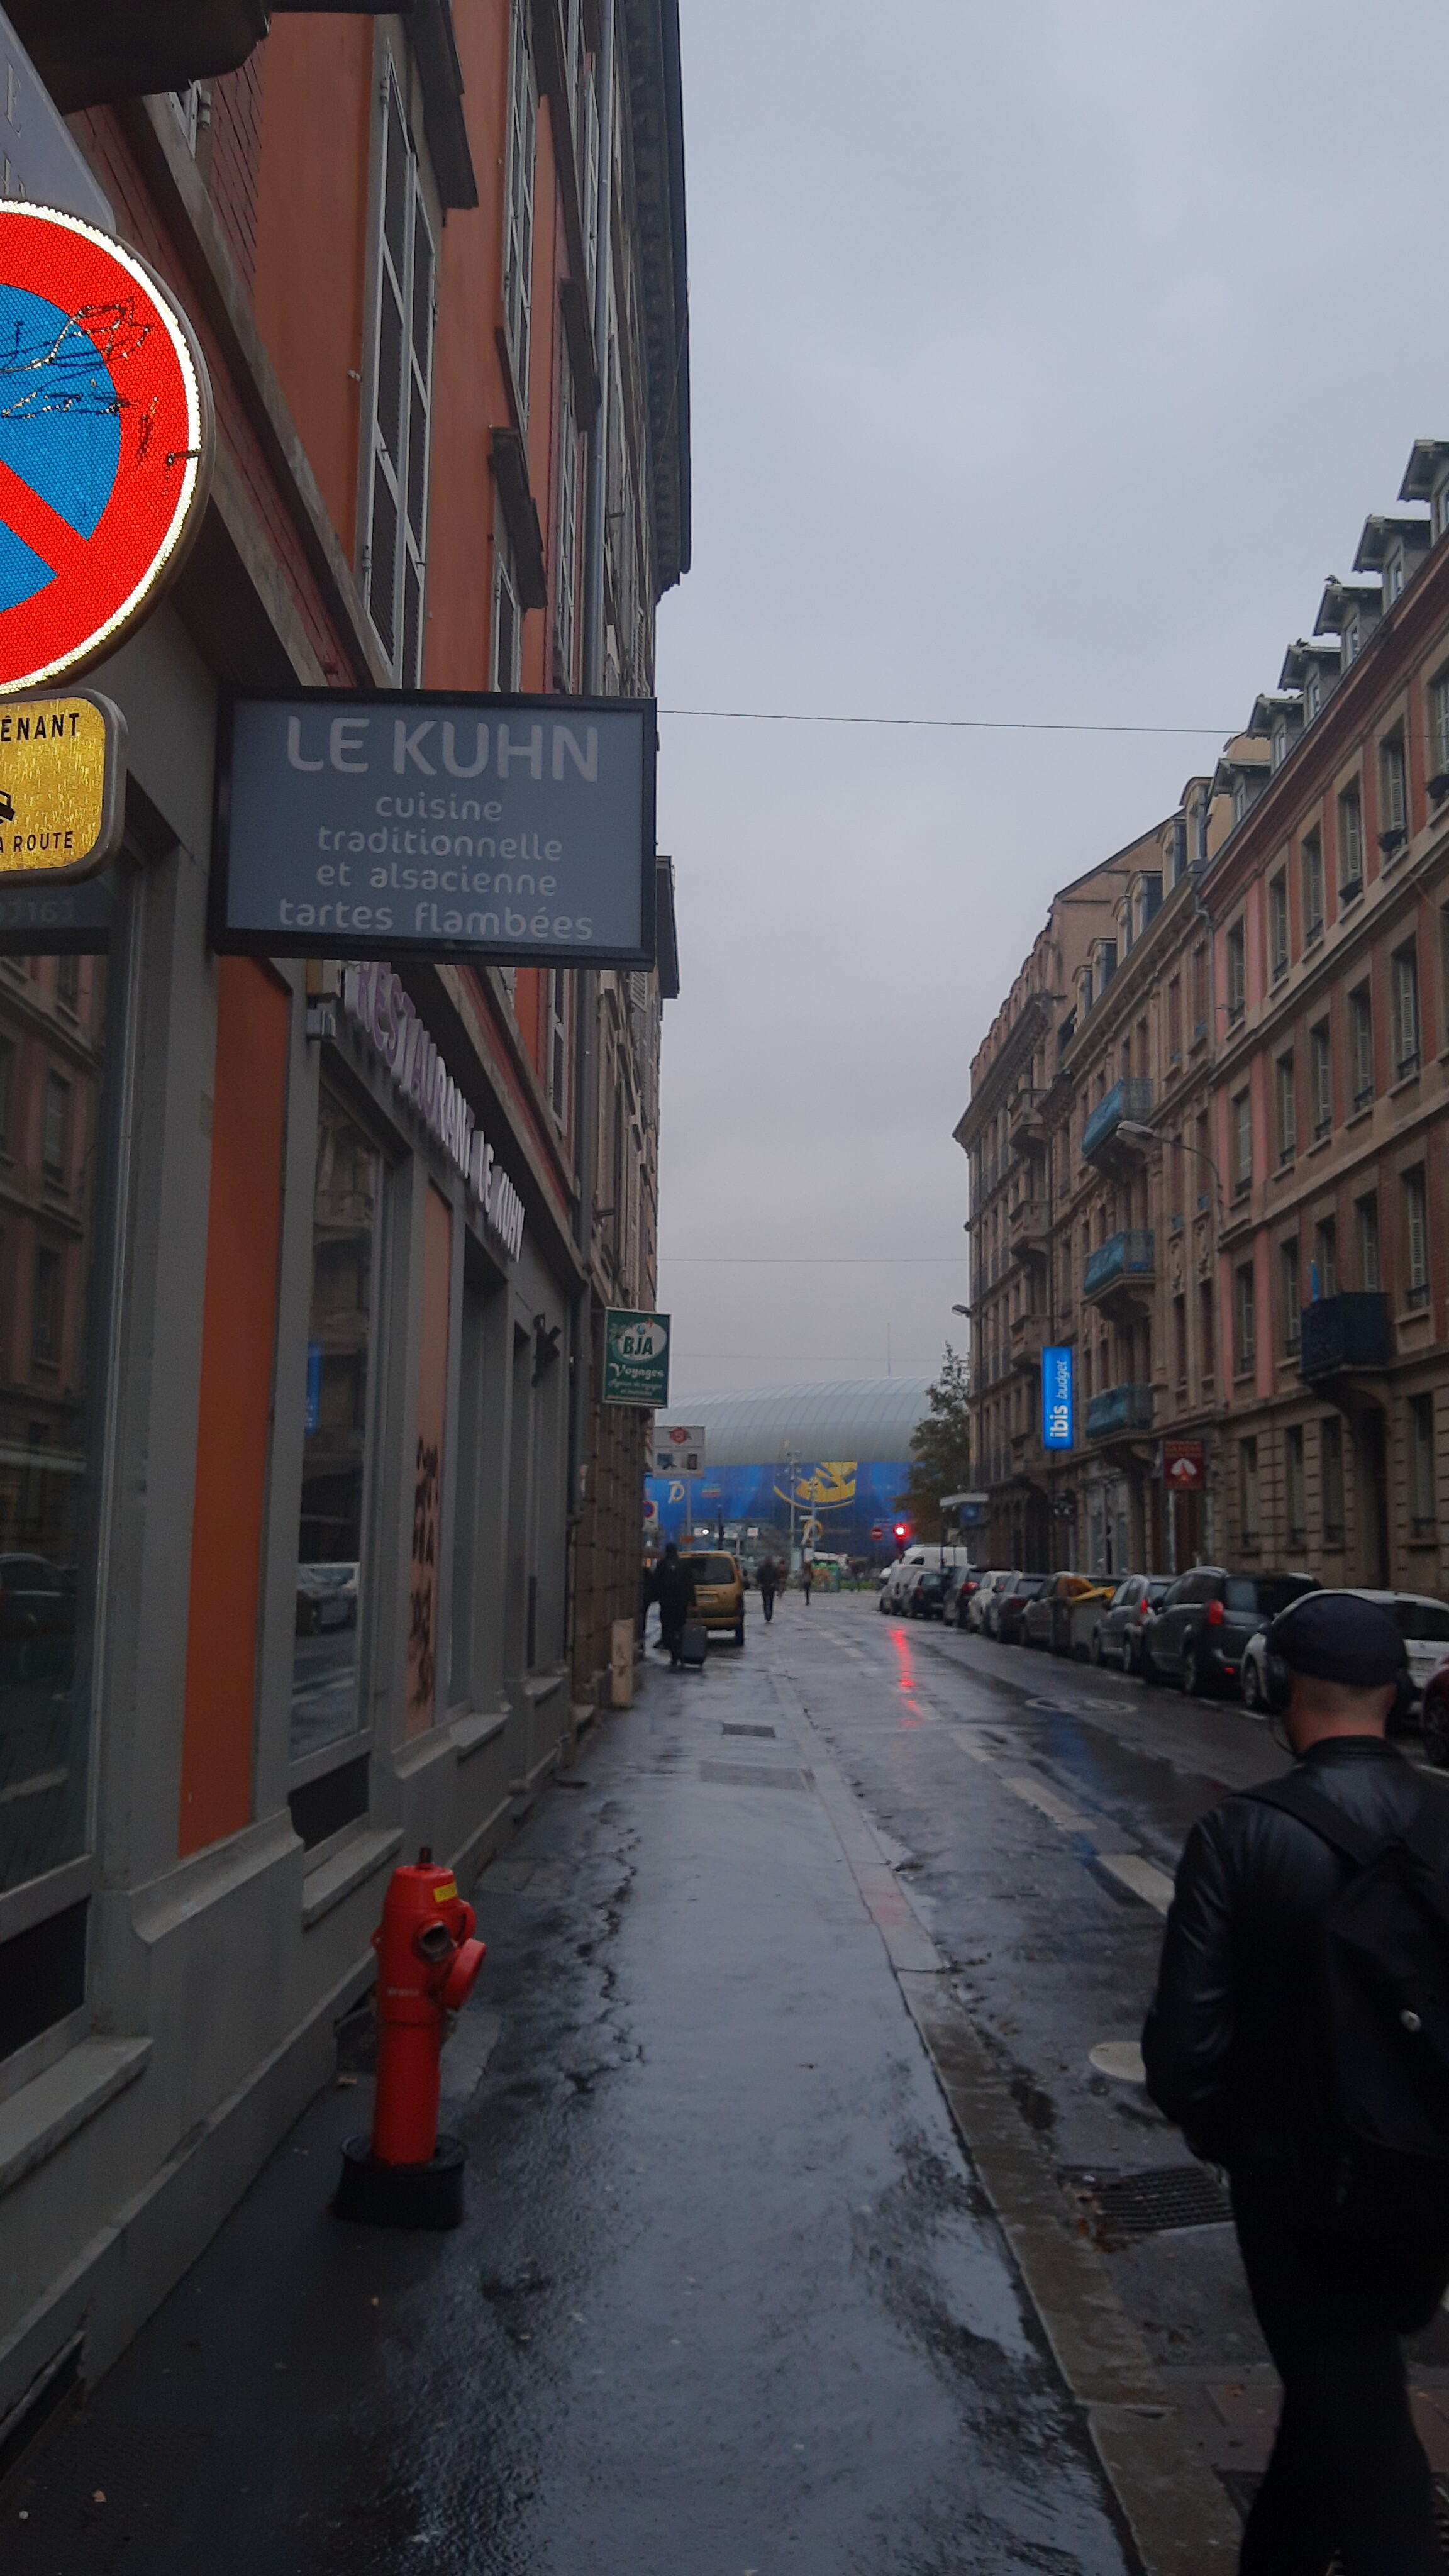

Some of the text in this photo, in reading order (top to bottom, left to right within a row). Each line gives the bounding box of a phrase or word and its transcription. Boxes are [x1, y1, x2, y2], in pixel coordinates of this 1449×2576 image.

[287, 716, 599, 783] LE KUHN
[377, 792, 502, 822] cuisine
[13, 831, 74, 853] ROUTE
[318, 826, 563, 862] traditionnelle
[316, 862, 557, 897] et alsacienne
[279, 899, 594, 940] tartes flambées
[623, 1336, 653, 1355] BJA
[609, 1363, 665, 1380] Voyages
[1049, 1360, 1070, 1438] ibis budget
